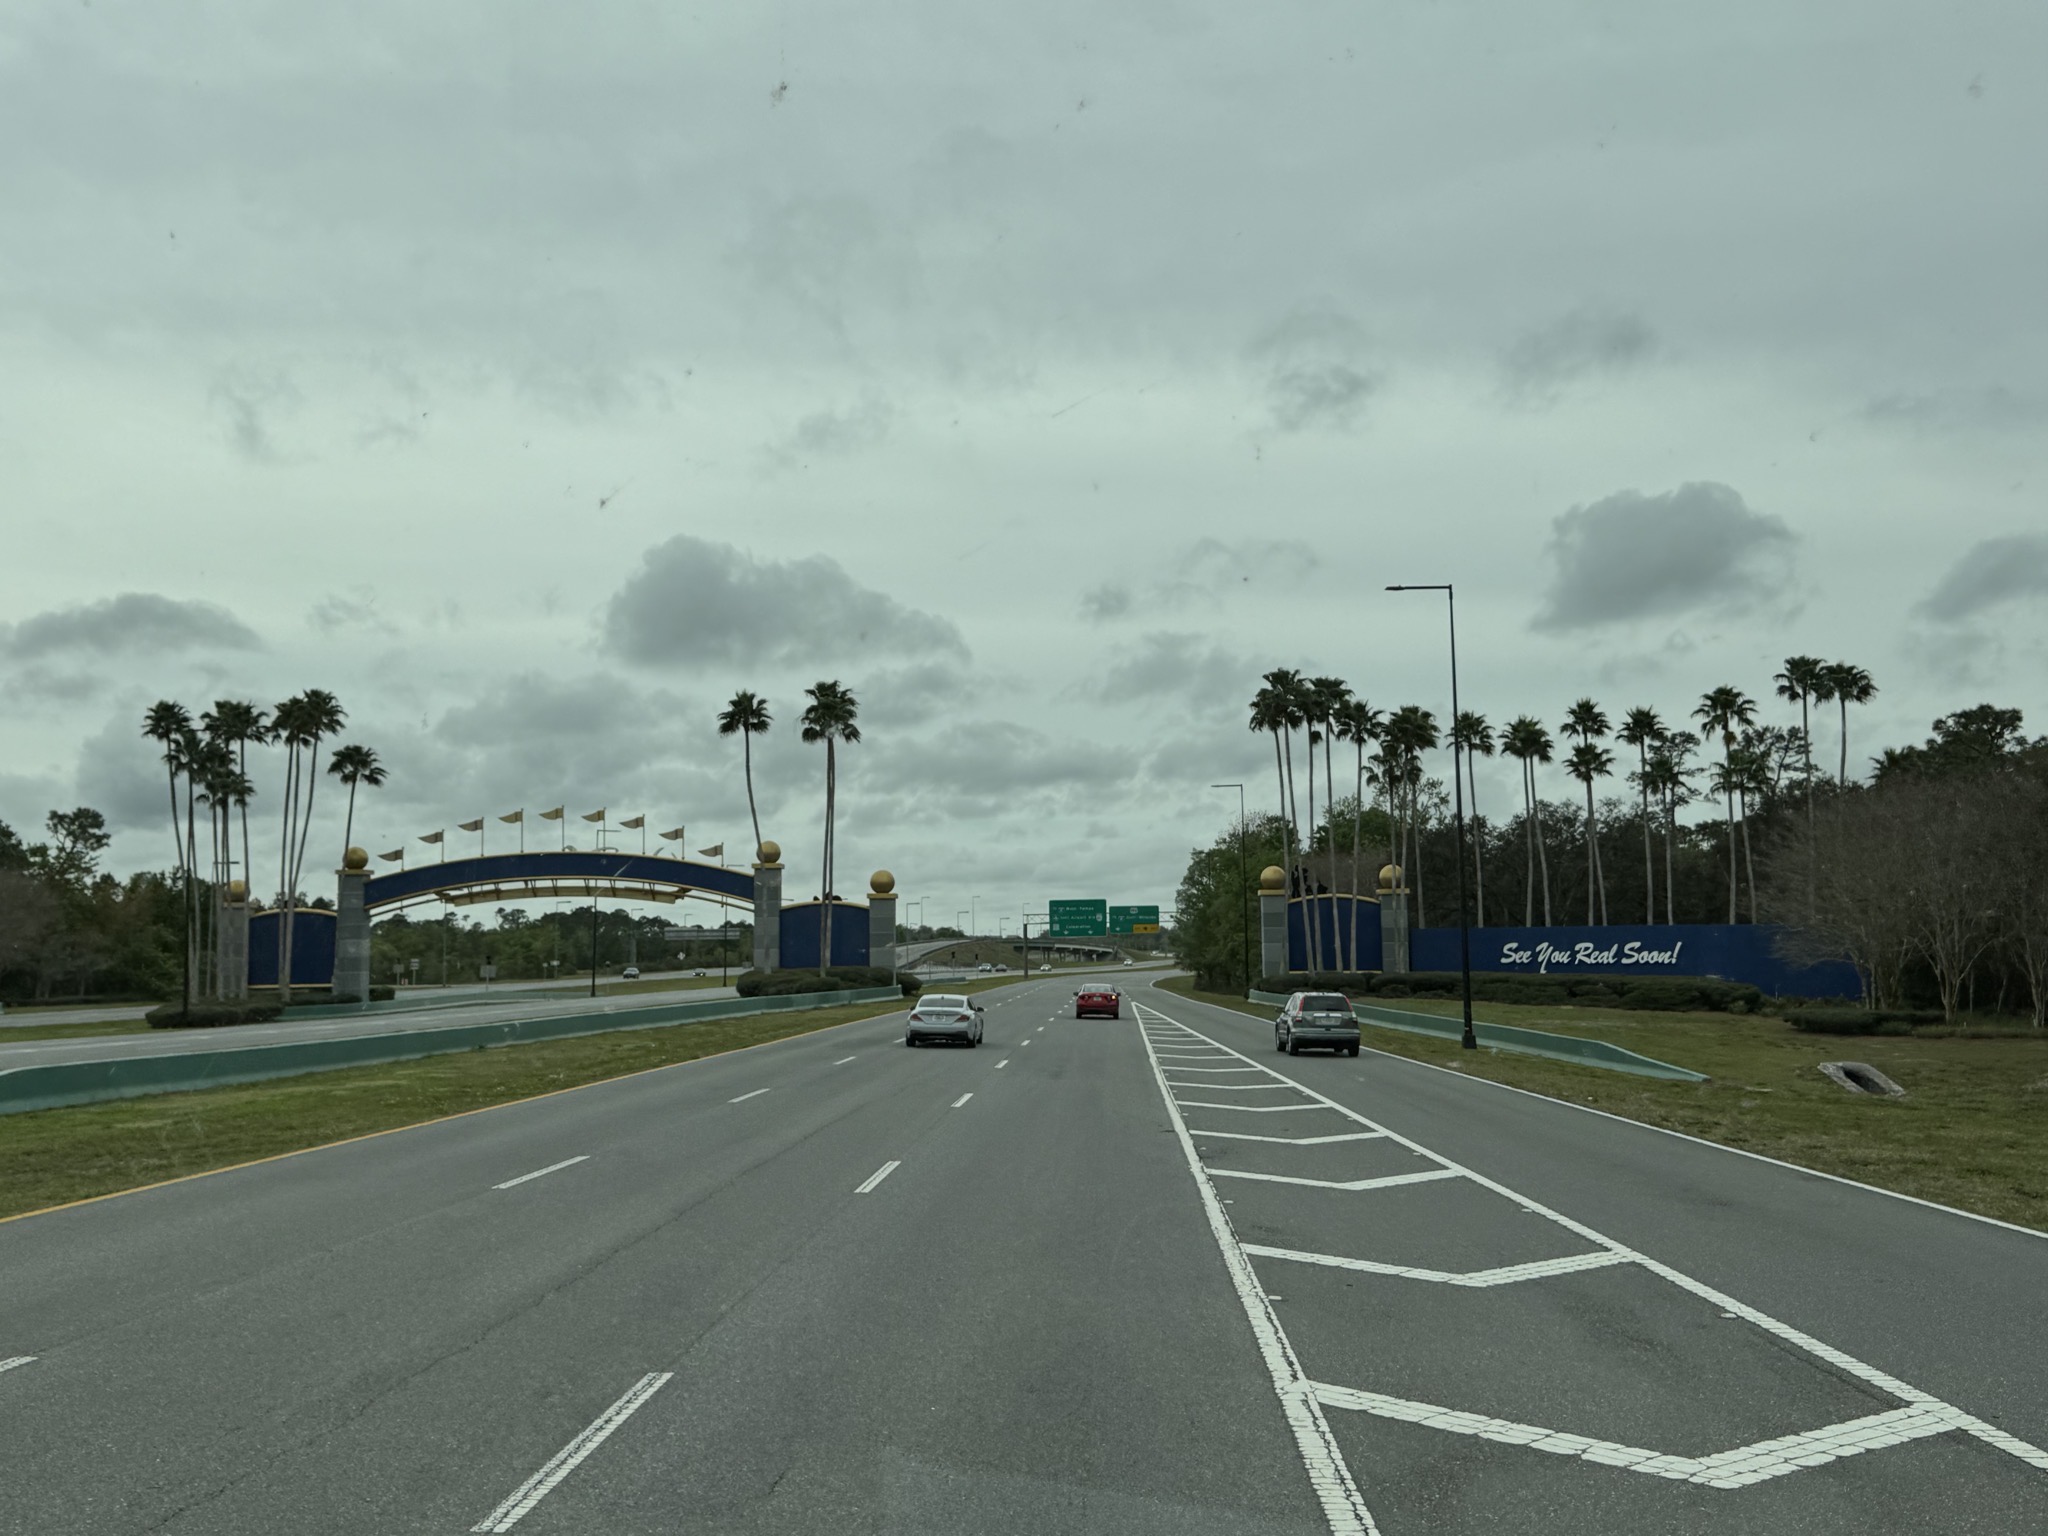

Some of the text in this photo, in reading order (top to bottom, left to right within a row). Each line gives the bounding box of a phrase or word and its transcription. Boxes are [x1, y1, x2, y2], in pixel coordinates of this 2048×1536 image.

[1500, 941, 1682, 974] See You Real Soon!
